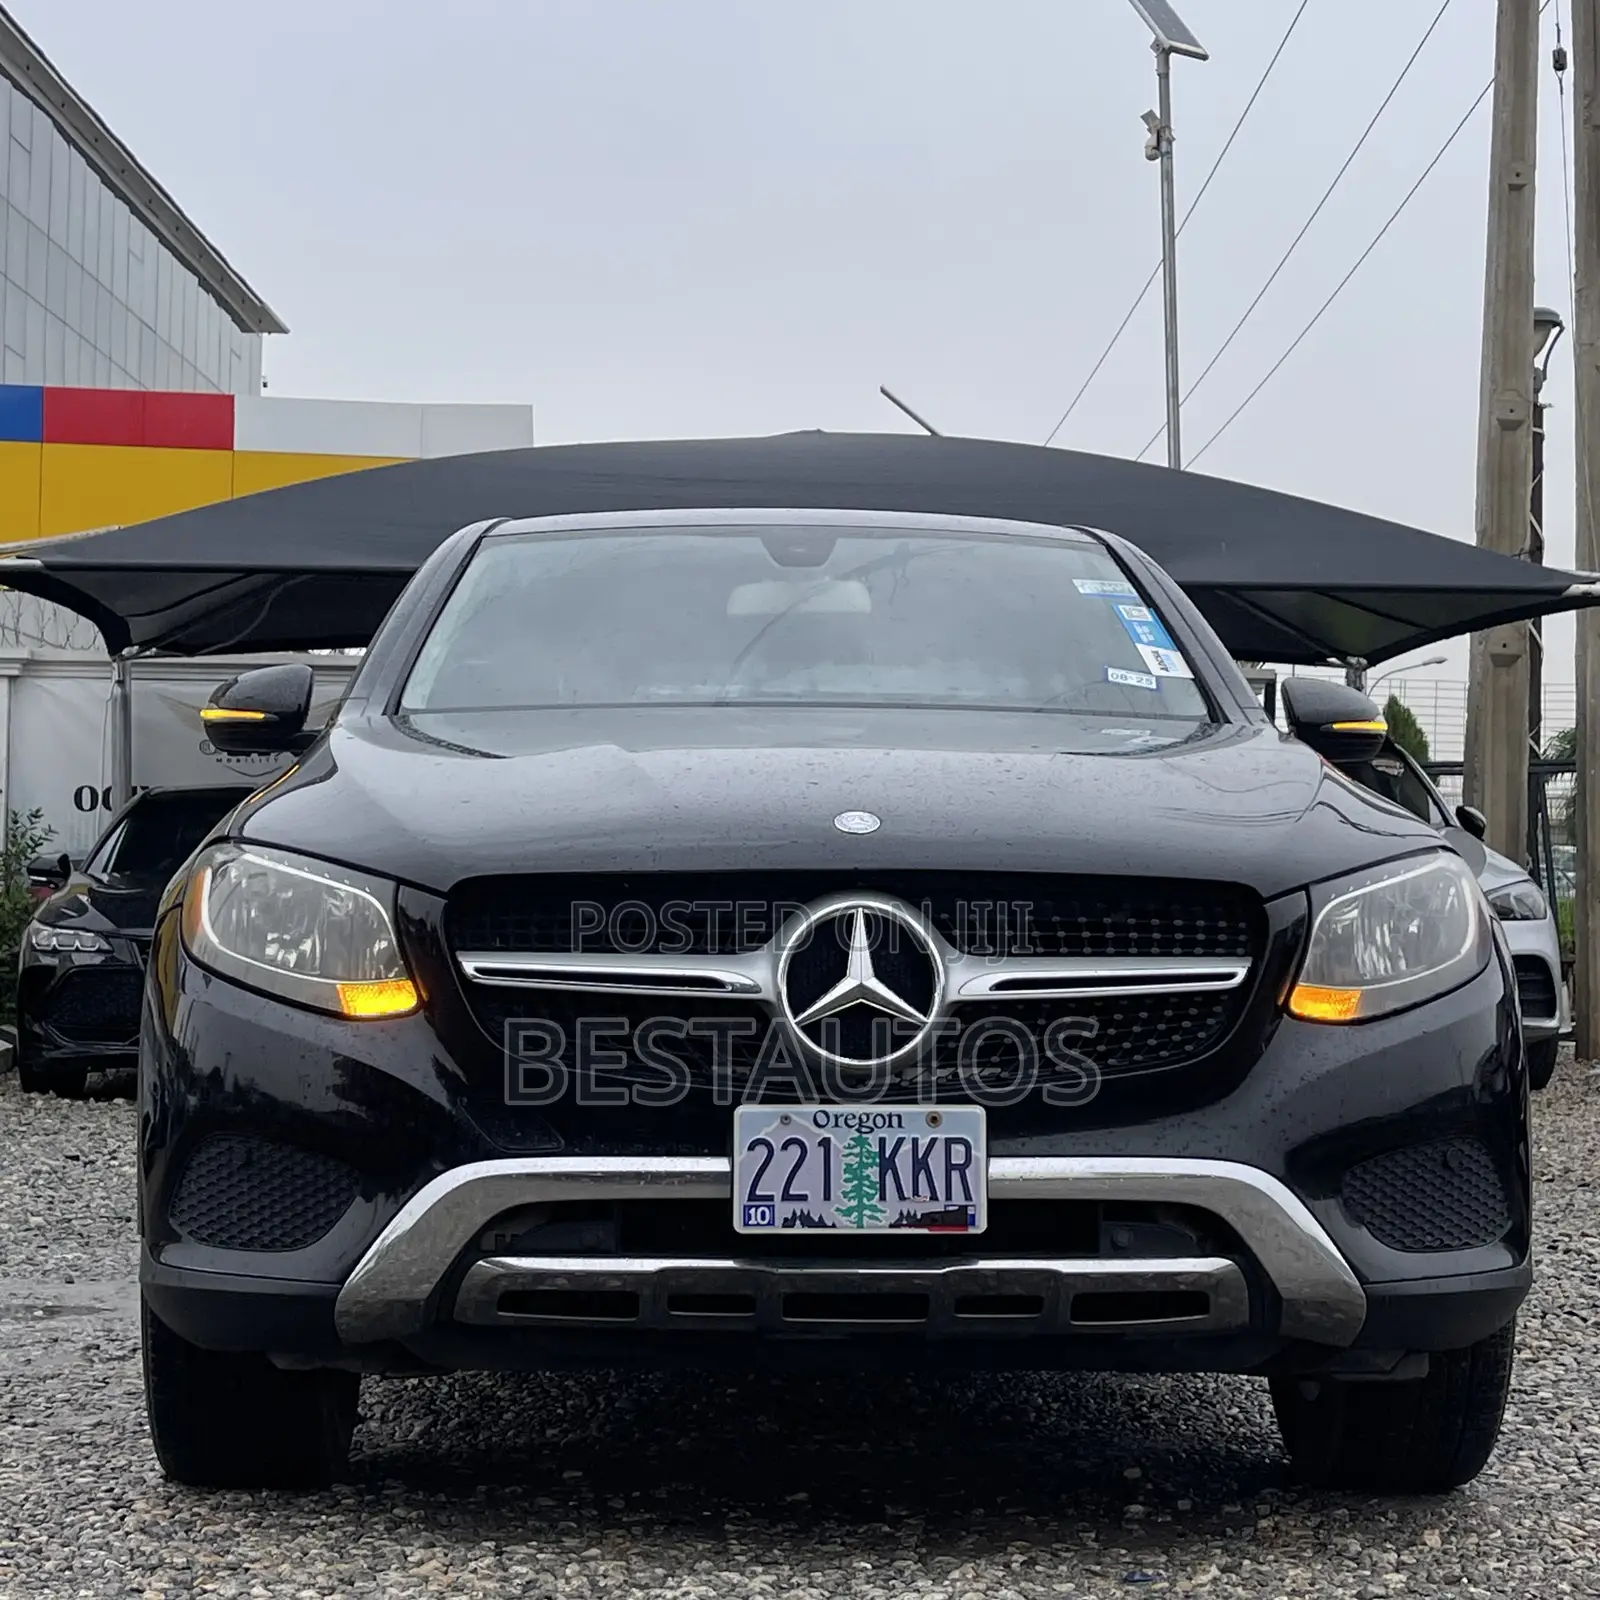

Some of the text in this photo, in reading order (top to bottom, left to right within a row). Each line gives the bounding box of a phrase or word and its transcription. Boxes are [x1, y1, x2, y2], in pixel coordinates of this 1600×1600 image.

[812, 1109, 905, 1135] Oregon
[746, 1136, 974, 1202] 221 KKR
[748, 1206, 771, 1226] 10
